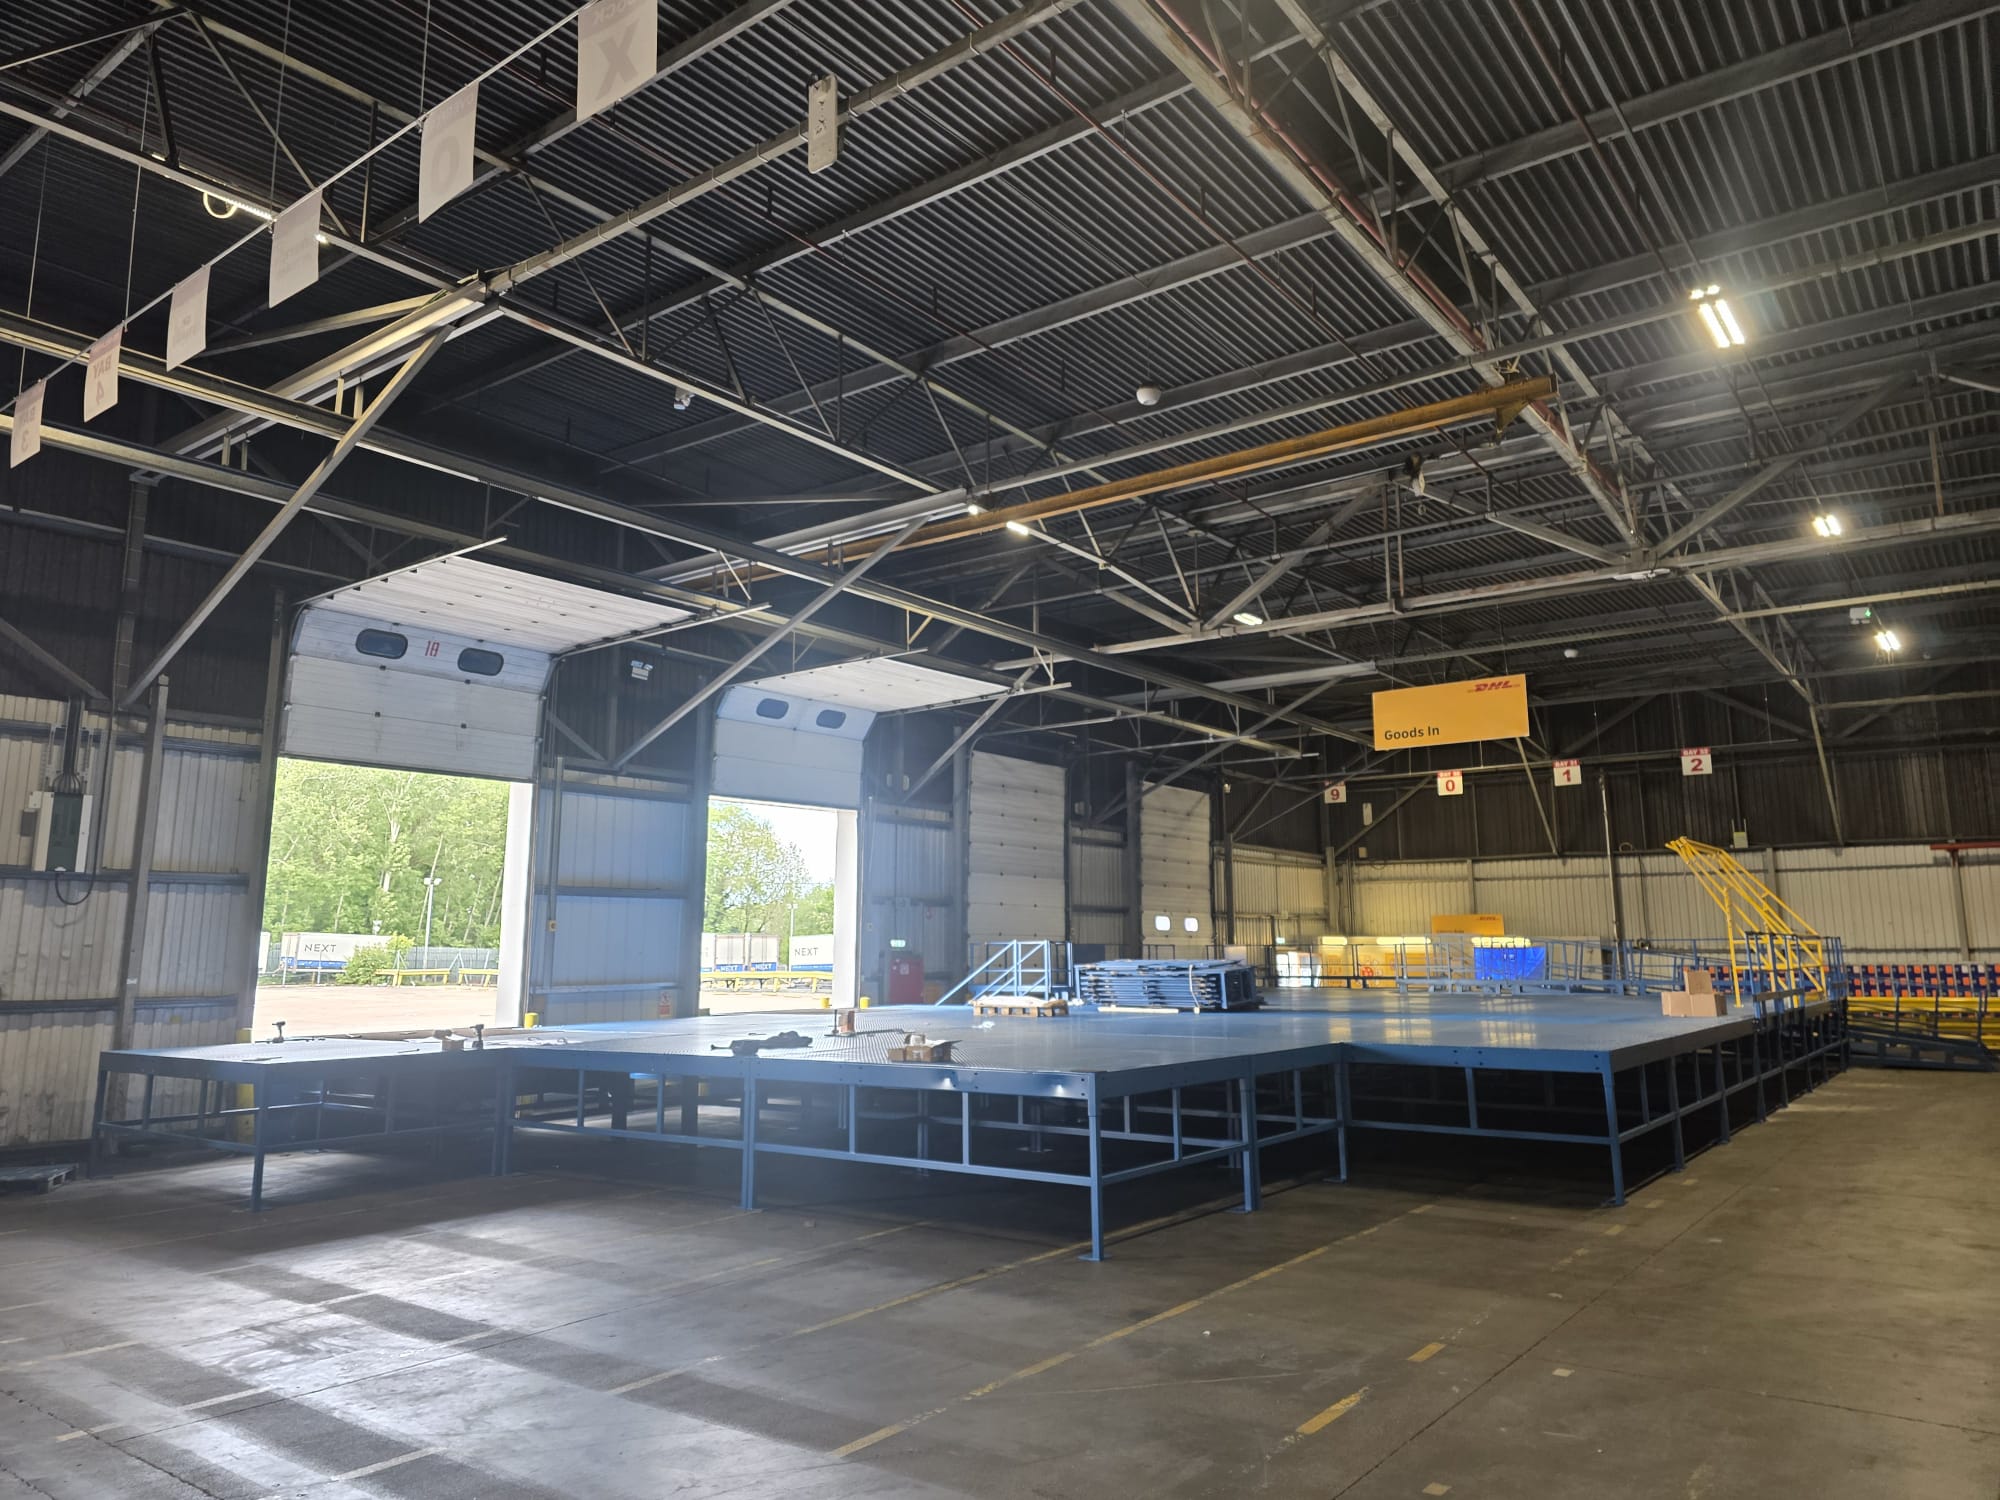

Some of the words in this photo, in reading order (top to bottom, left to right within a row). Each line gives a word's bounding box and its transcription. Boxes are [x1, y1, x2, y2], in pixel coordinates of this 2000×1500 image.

[1474, 681, 1512, 692] DHL
[1384, 726, 1424, 741] Goods
[1427, 726, 1440, 737] In
[1691, 758, 1704, 772] 2
[1562, 769, 1571, 782] 1
[1331, 788, 1340, 800] 9
[304, 943, 337, 952] NEXT
[794, 947, 819, 957] NEXT
